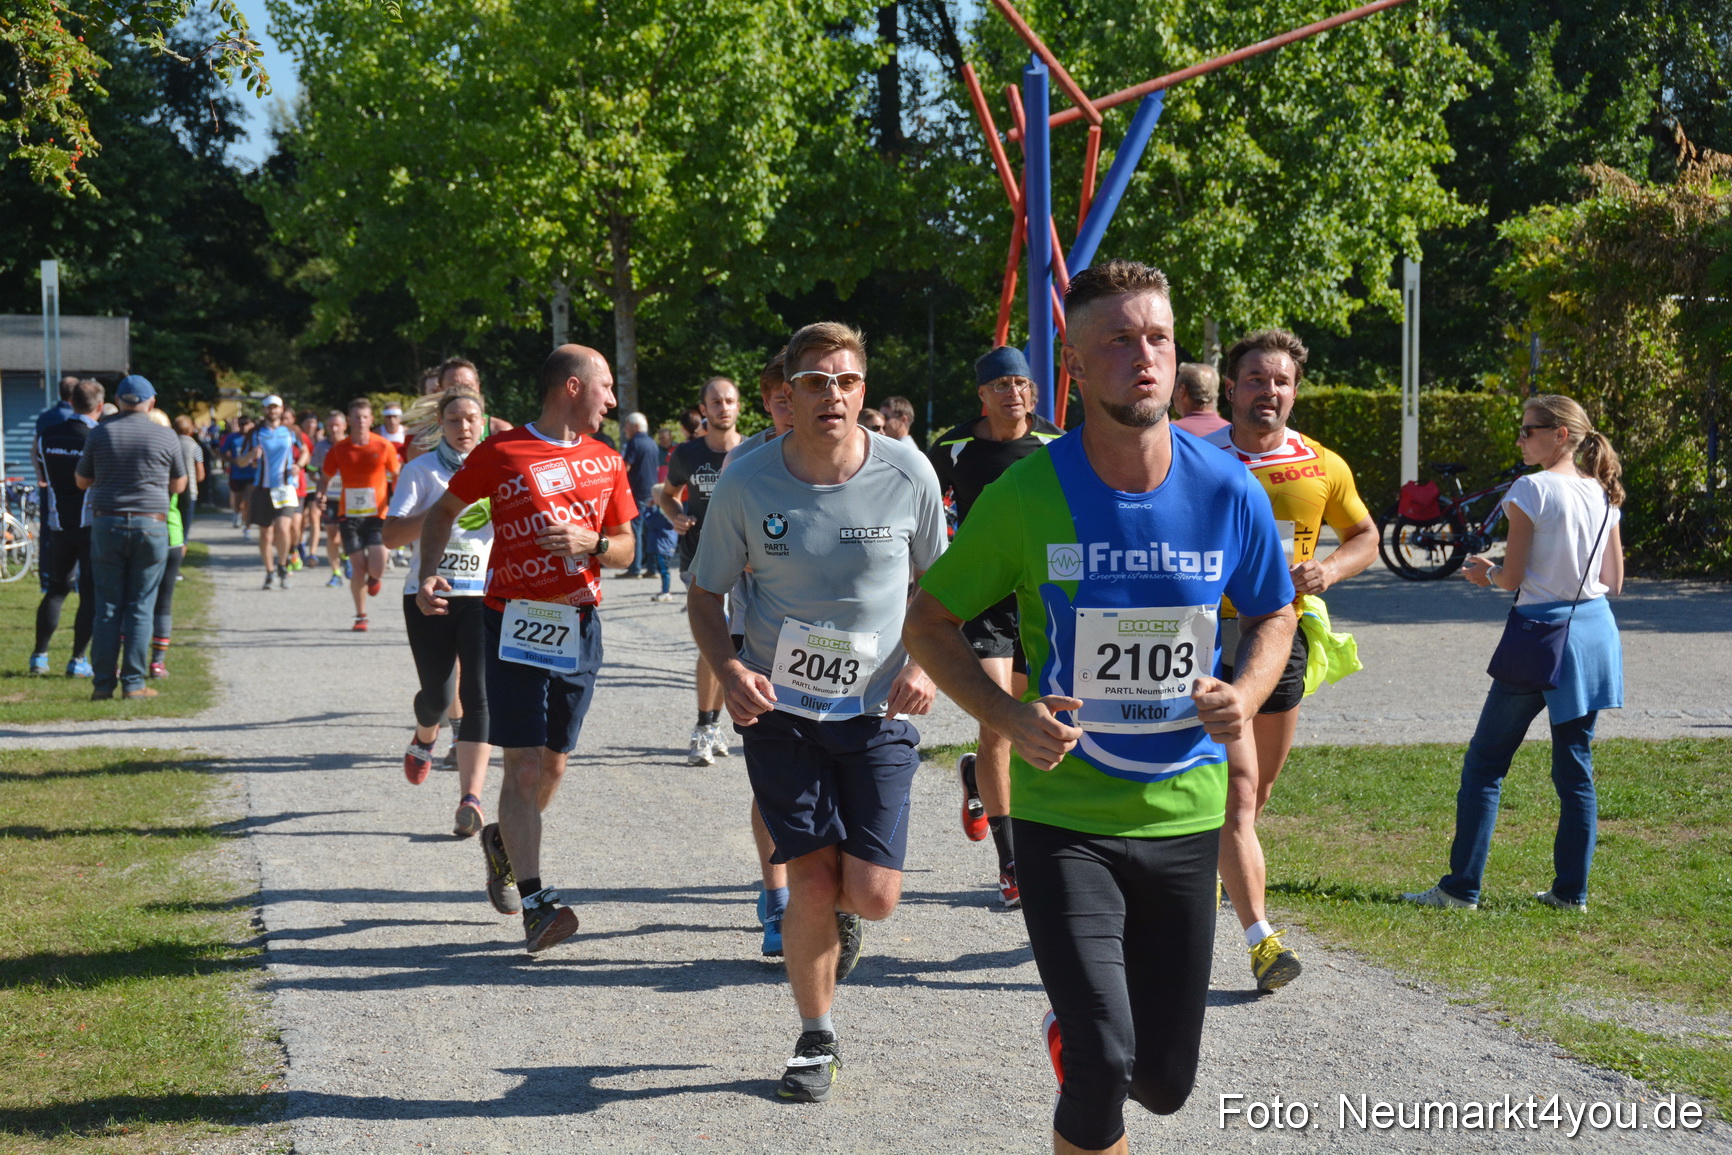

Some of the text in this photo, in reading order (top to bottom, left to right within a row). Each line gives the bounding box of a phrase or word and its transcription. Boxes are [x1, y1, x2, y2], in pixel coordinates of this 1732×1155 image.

[533, 461, 564, 473] raumbox
[1269, 465, 1326, 485] BÖGL
[840, 526, 893, 539] BOCK
[764, 543, 789, 551] PARTL
[438, 553, 480, 572] 2259
[1089, 542, 1224, 582] Freitag
[1089, 572, 1127, 583] Energie
[1127, 572, 1139, 580] ist
[1173, 572, 1204, 581] Stärke
[528, 607, 562, 619] BOCK
[512, 619, 570, 647] 2227
[1118, 620, 1180, 632] BOCK
[807, 634, 852, 651] BOCK
[524, 651, 554, 664] Tobias
[1096, 642, 1194, 681] 2103
[788, 648, 860, 686] 2043
[792, 679, 840, 694] PARTL Neumarkt
[1105, 687, 1175, 695] PARTL Neumarkt
[801, 695, 833, 711] Oliver
[1121, 704, 1169, 720] Viktor
